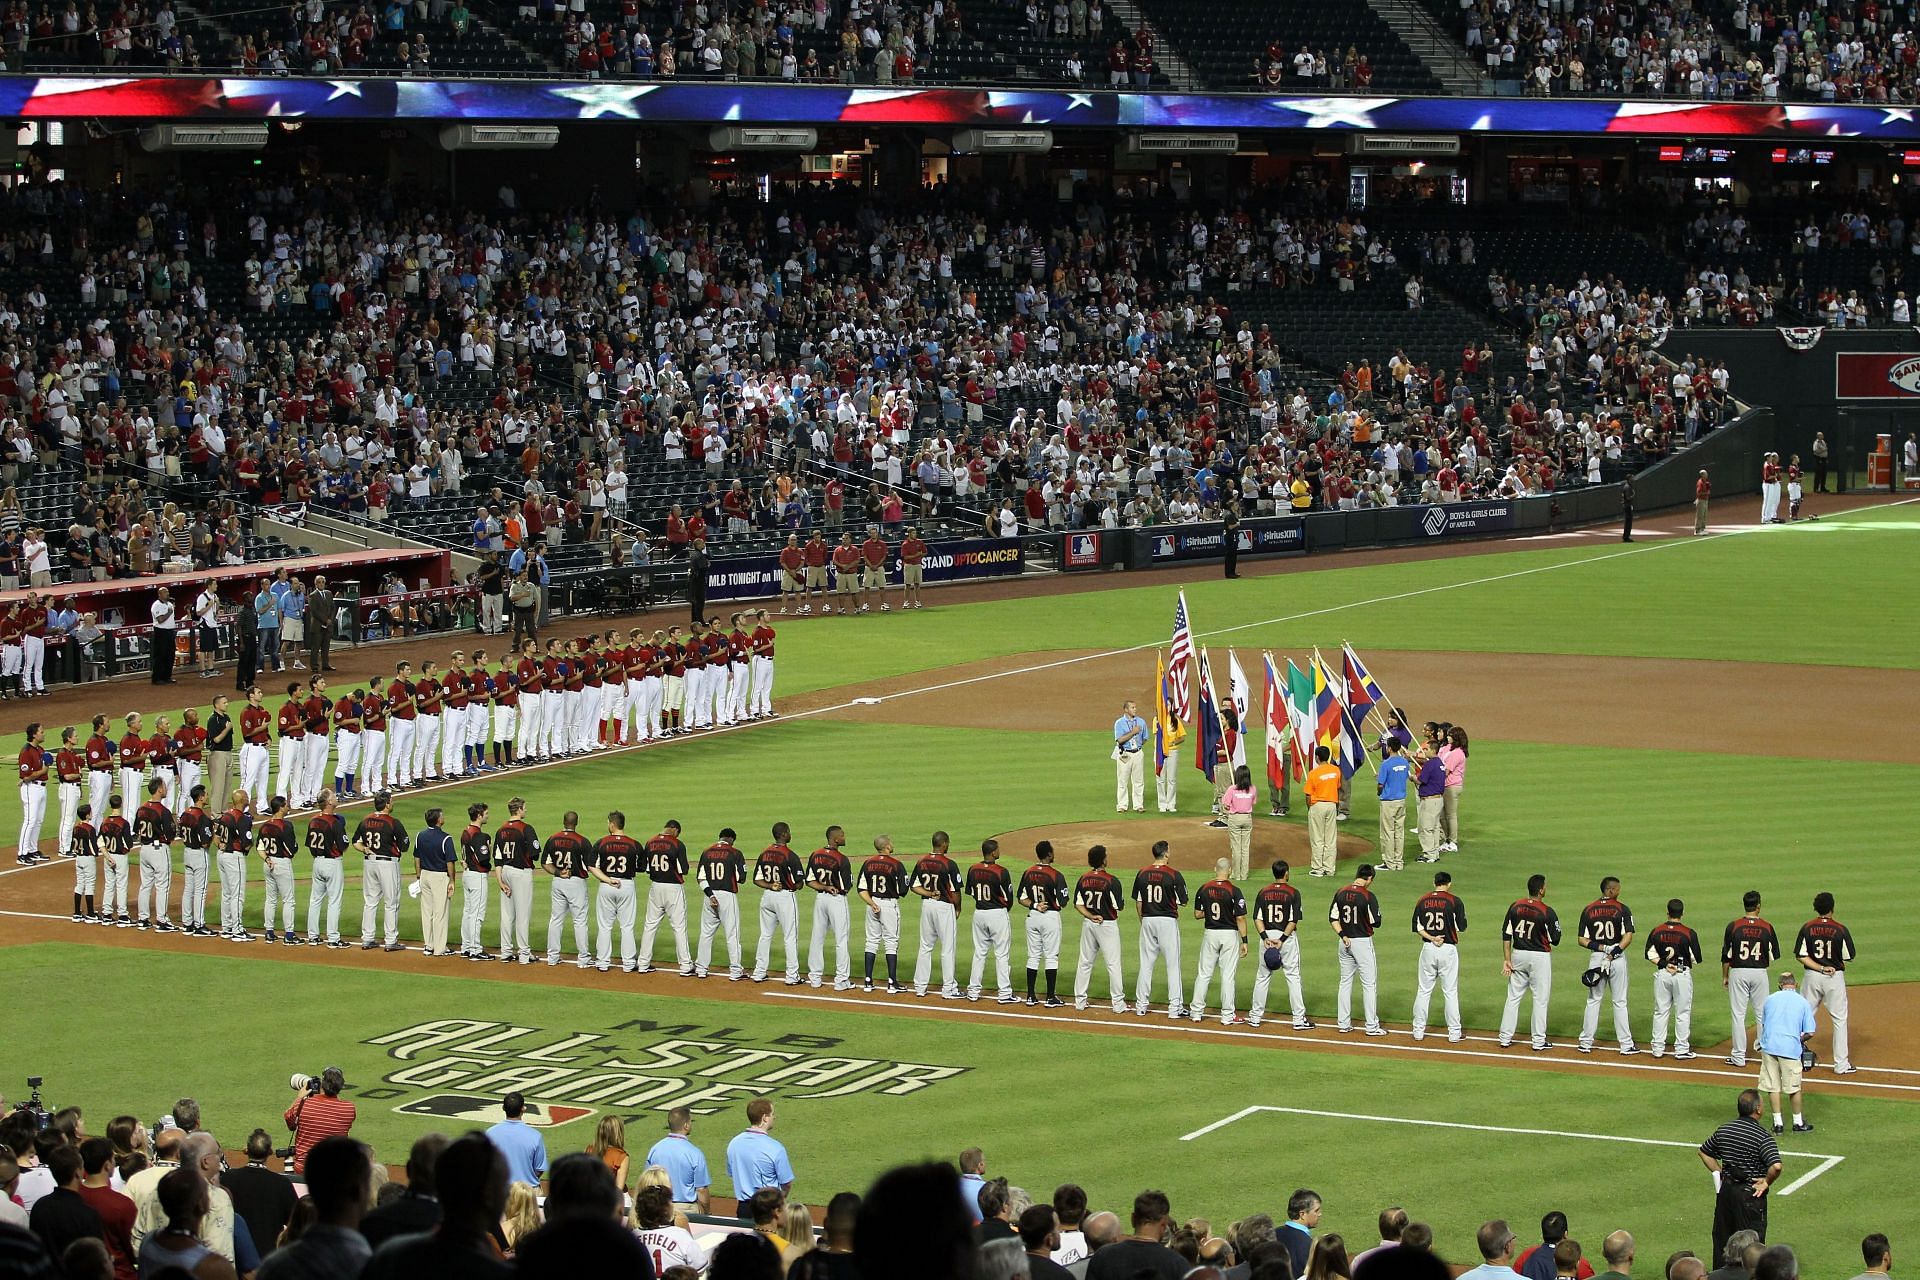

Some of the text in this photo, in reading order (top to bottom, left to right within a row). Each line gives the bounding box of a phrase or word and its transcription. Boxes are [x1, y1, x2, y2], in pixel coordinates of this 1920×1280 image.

[1450, 512, 1464, 520] BOYS
[1471, 510, 1488, 518] GIRLS
[1488, 508, 1506, 517] CLUBS
[708, 573, 726, 588] MLB
[728, 572, 761, 586] TONIGHT
[762, 573, 770, 582] on
[140, 821, 153, 837] 20
[263, 837, 278, 855] 25
[310, 832, 325, 850] 22
[366, 832, 381, 850] 33
[504, 842, 516, 859] 47
[554, 851, 573, 869] 24
[606, 855, 627, 873] 23
[651, 854, 670, 872] 46
[710, 862, 725, 880] 10
[764, 865, 780, 882] 36
[872, 875, 887, 893] 13
[922, 874, 939, 891] 27
[976, 883, 991, 902] 10
[1085, 890, 1102, 909] 27
[1146, 884, 1163, 903] 10
[1211, 902, 1220, 921] 9
[1267, 904, 1283, 923] 15
[1343, 905, 1358, 924] 31
[1425, 912, 1445, 930] 25
[1515, 919, 1536, 940] 47
[1594, 920, 1615, 940] 20
[1739, 940, 1762, 960] 54
[1814, 940, 1833, 959] 31
[616, 1017, 845, 1050] MLB
[360, 1017, 976, 1101] ALL STAR
[381, 1055, 794, 1117] GAME
